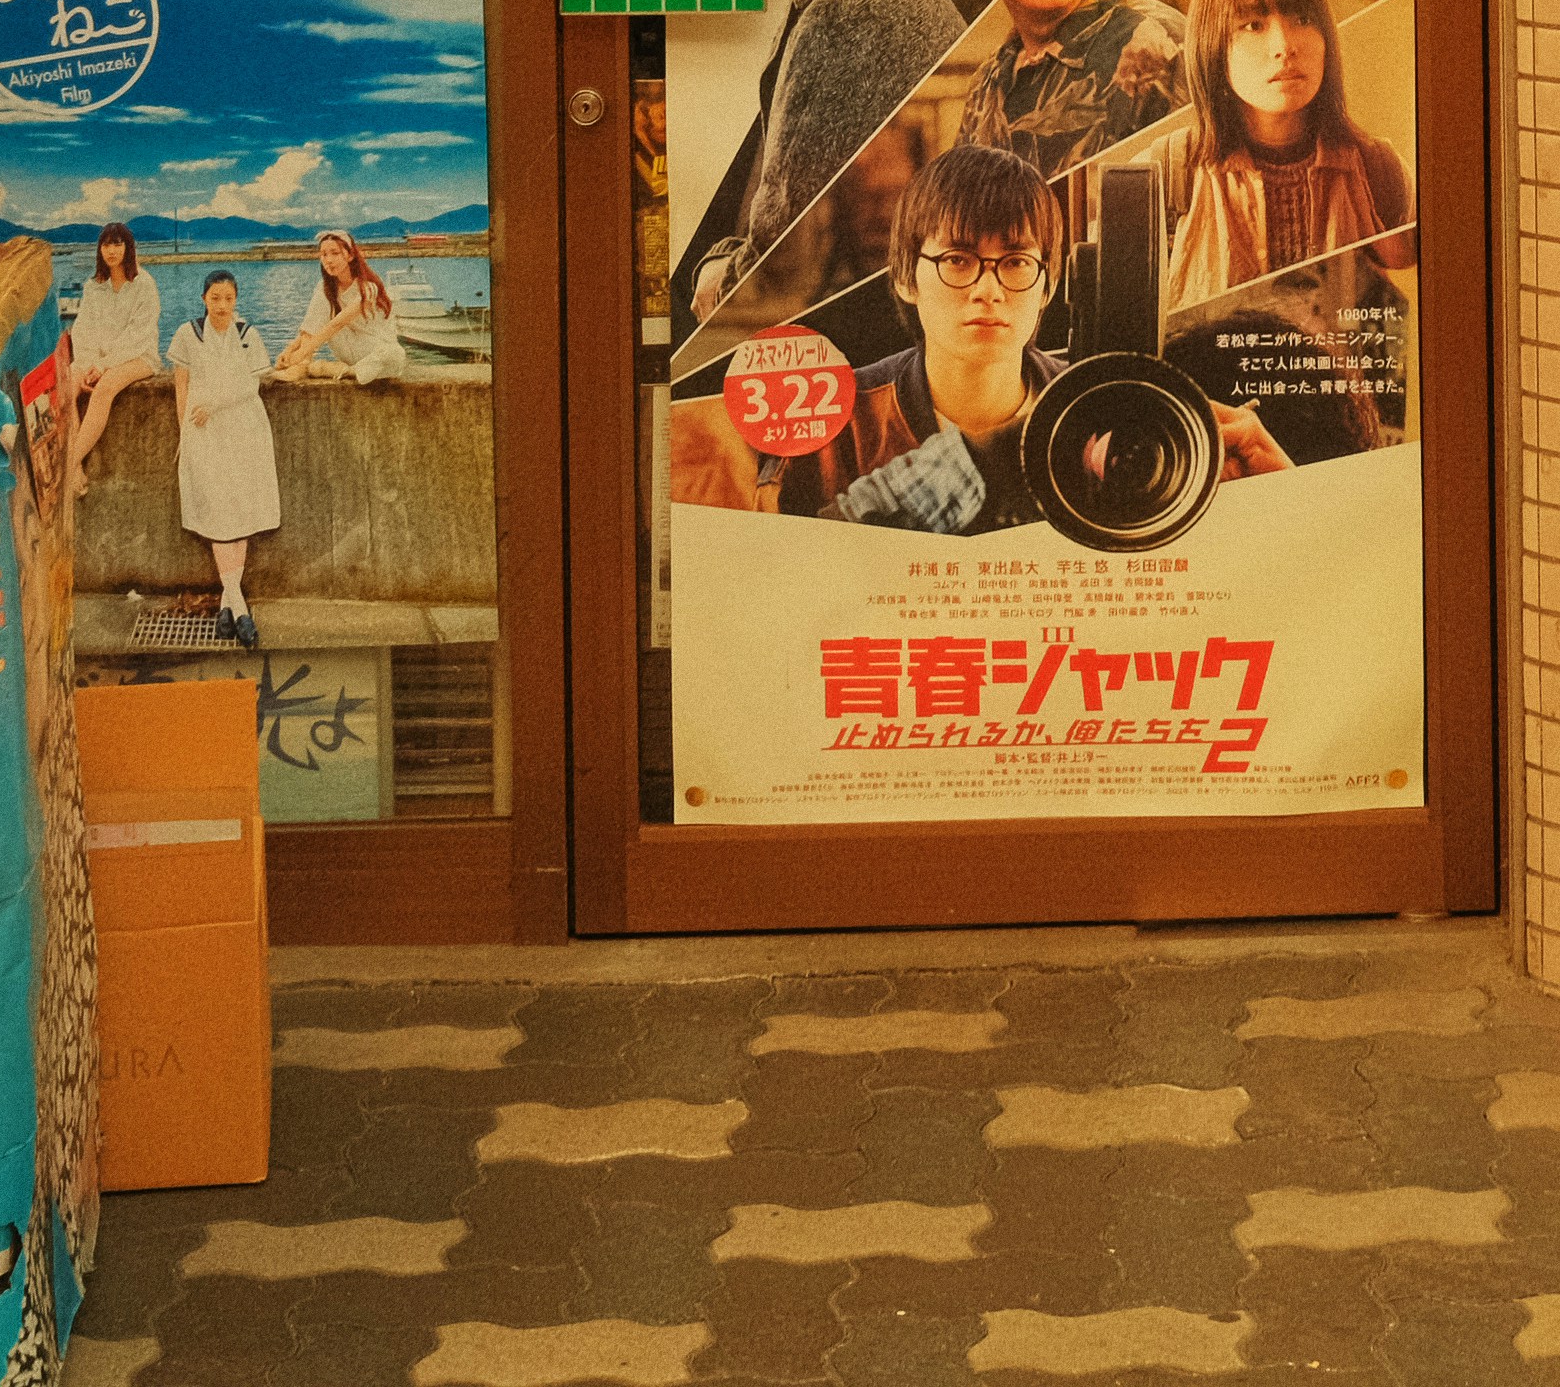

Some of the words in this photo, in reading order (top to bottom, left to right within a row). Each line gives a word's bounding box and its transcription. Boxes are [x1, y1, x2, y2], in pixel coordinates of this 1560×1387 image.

[8, 63, 73, 90] Akiyoshi
[77, 52, 137, 75] Imazeki
[61, 86, 92, 104] Film
[1336, 307, 1405, 324] 1980年代、
[1215, 329, 1405, 349] 若松孝二が作ったミニシアター。
[1238, 355, 1405, 371] そこで人は映画に出会った。
[742, 373, 841, 424] 3.22
[946, 561, 960, 576] 新
[978, 560, 1040, 575] 東出昌大
[1095, 560, 1110, 575] 悠
[820, 630, 1274, 720] 青春ジャック
[833, 718, 1210, 748] 止められるか、俺たちを
[1202, 717, 1268, 773] 2
